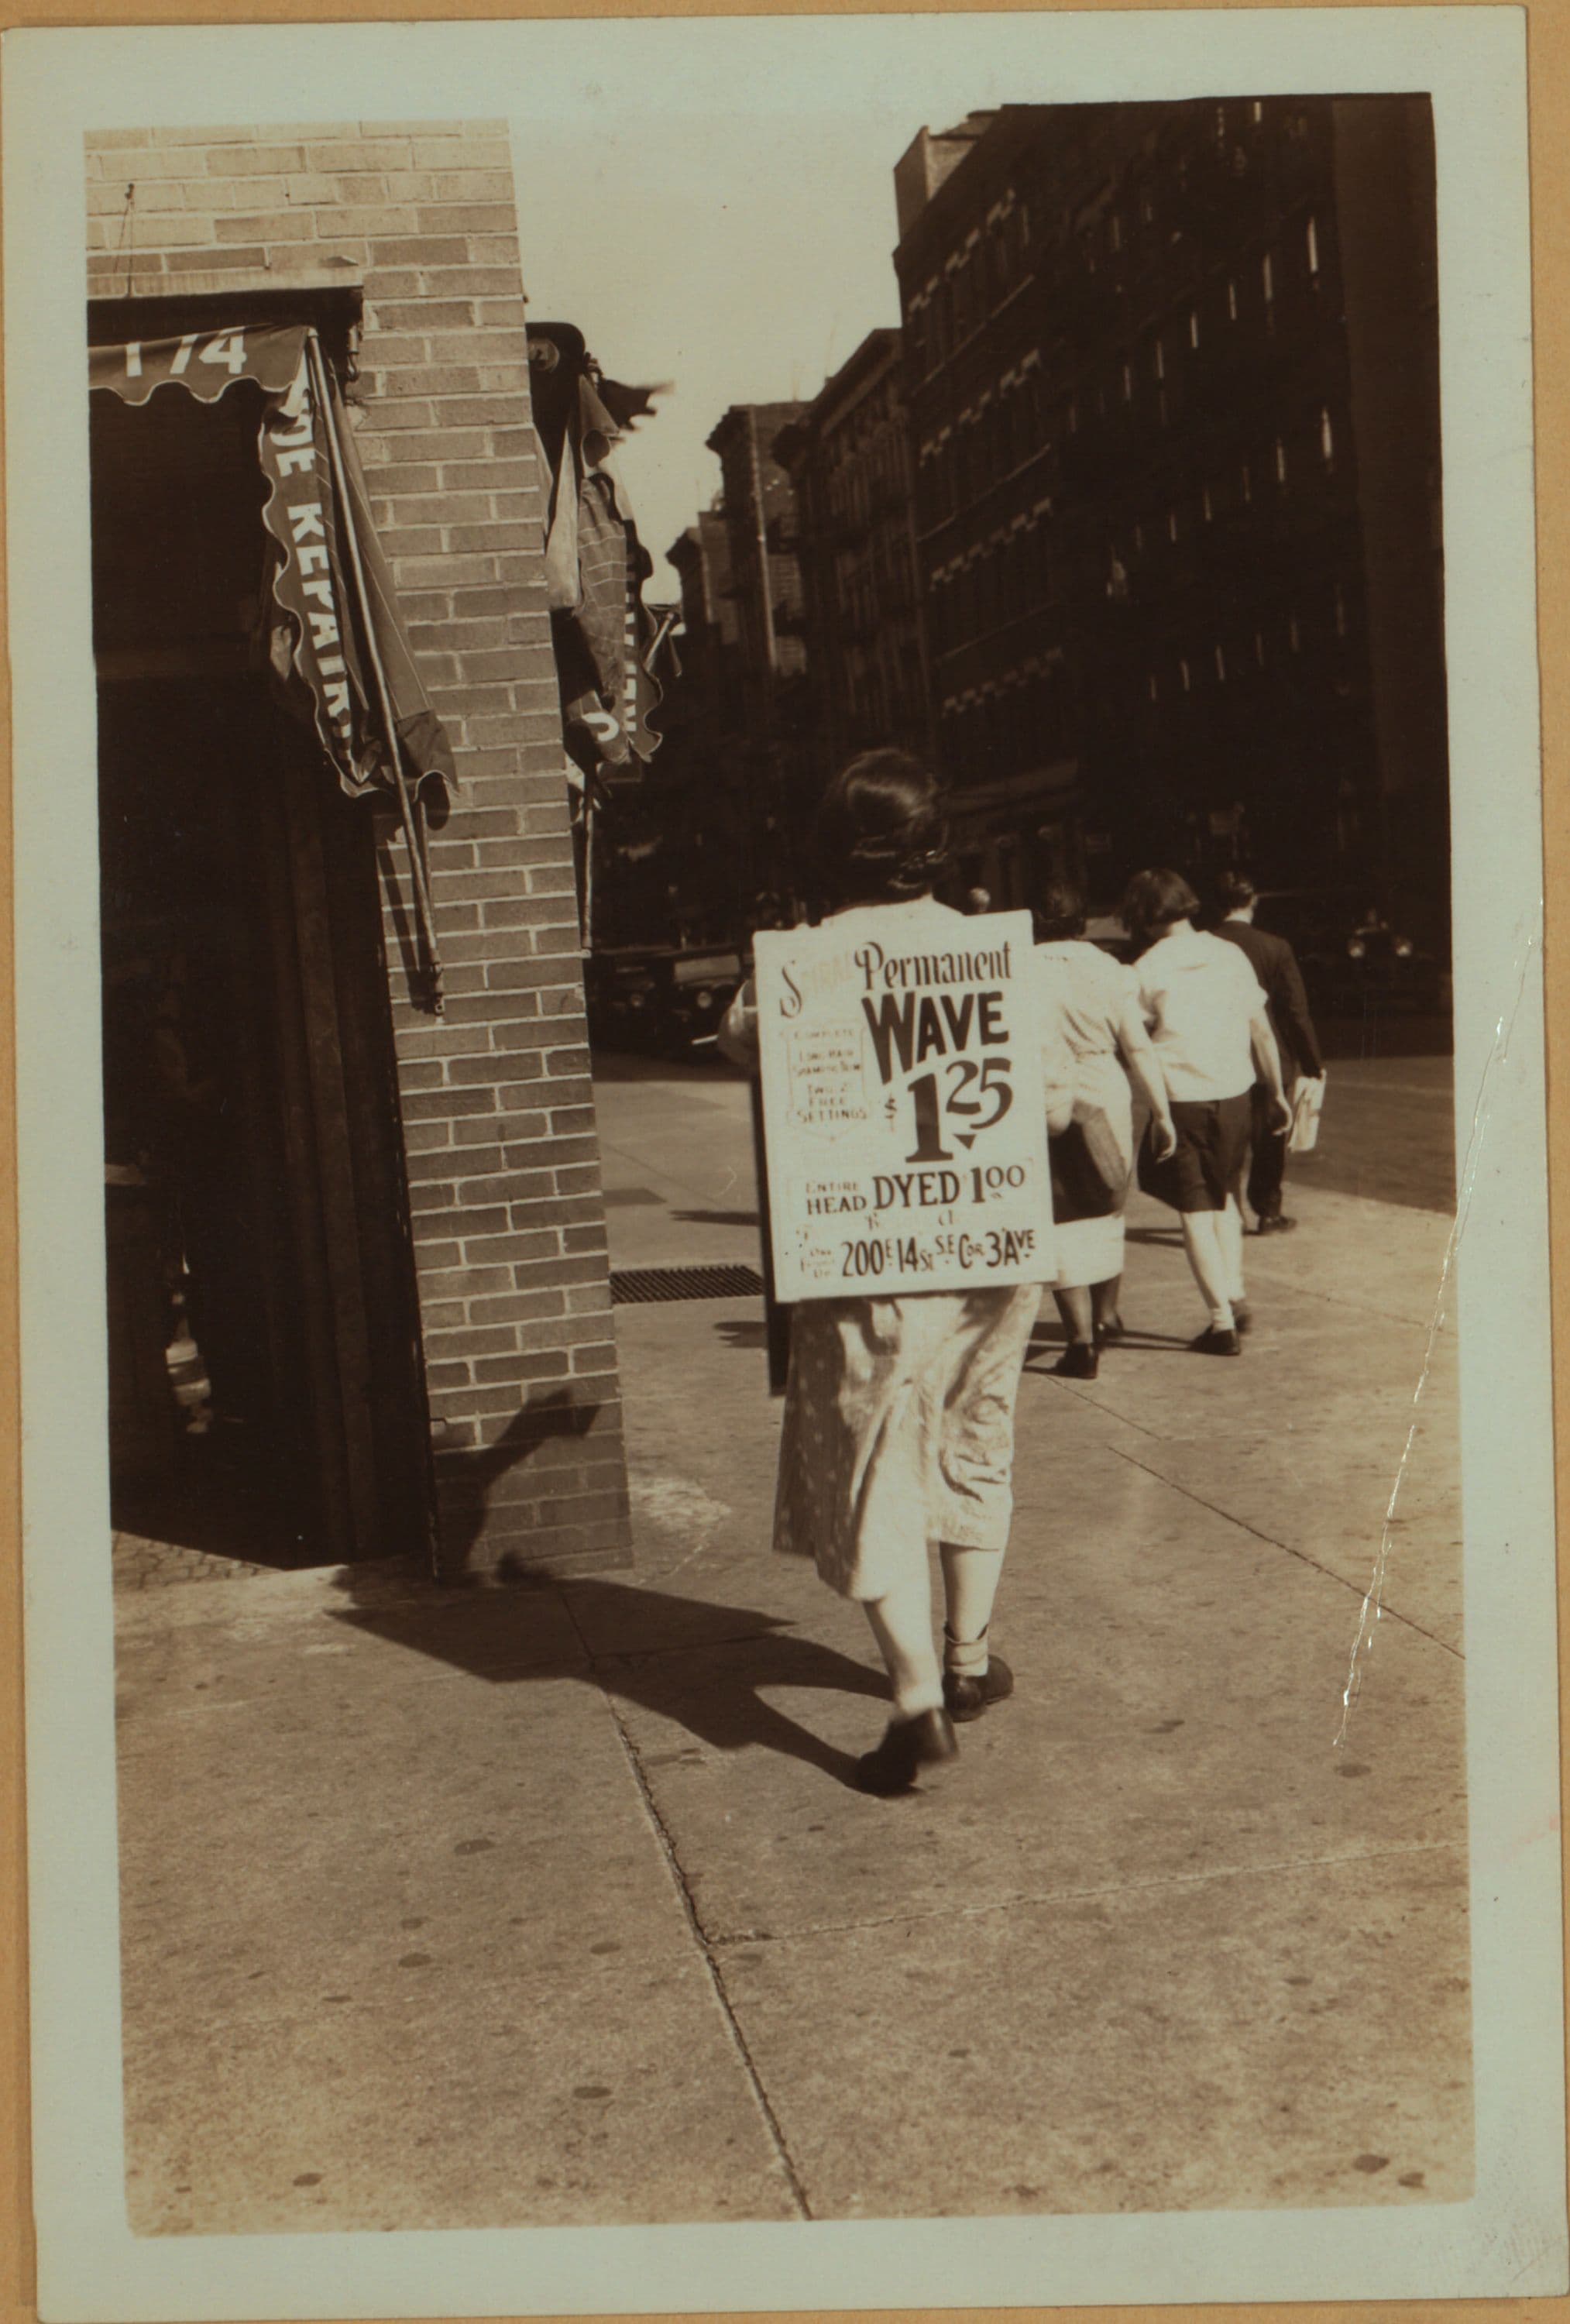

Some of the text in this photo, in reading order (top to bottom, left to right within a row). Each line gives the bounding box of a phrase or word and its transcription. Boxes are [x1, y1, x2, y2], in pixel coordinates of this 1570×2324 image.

[854, 940, 1012, 991] Permanent
[860, 990, 1010, 1086] WAVE
[806, 1195, 868, 1215] HEAD
[871, 1170, 961, 1211] DYED
